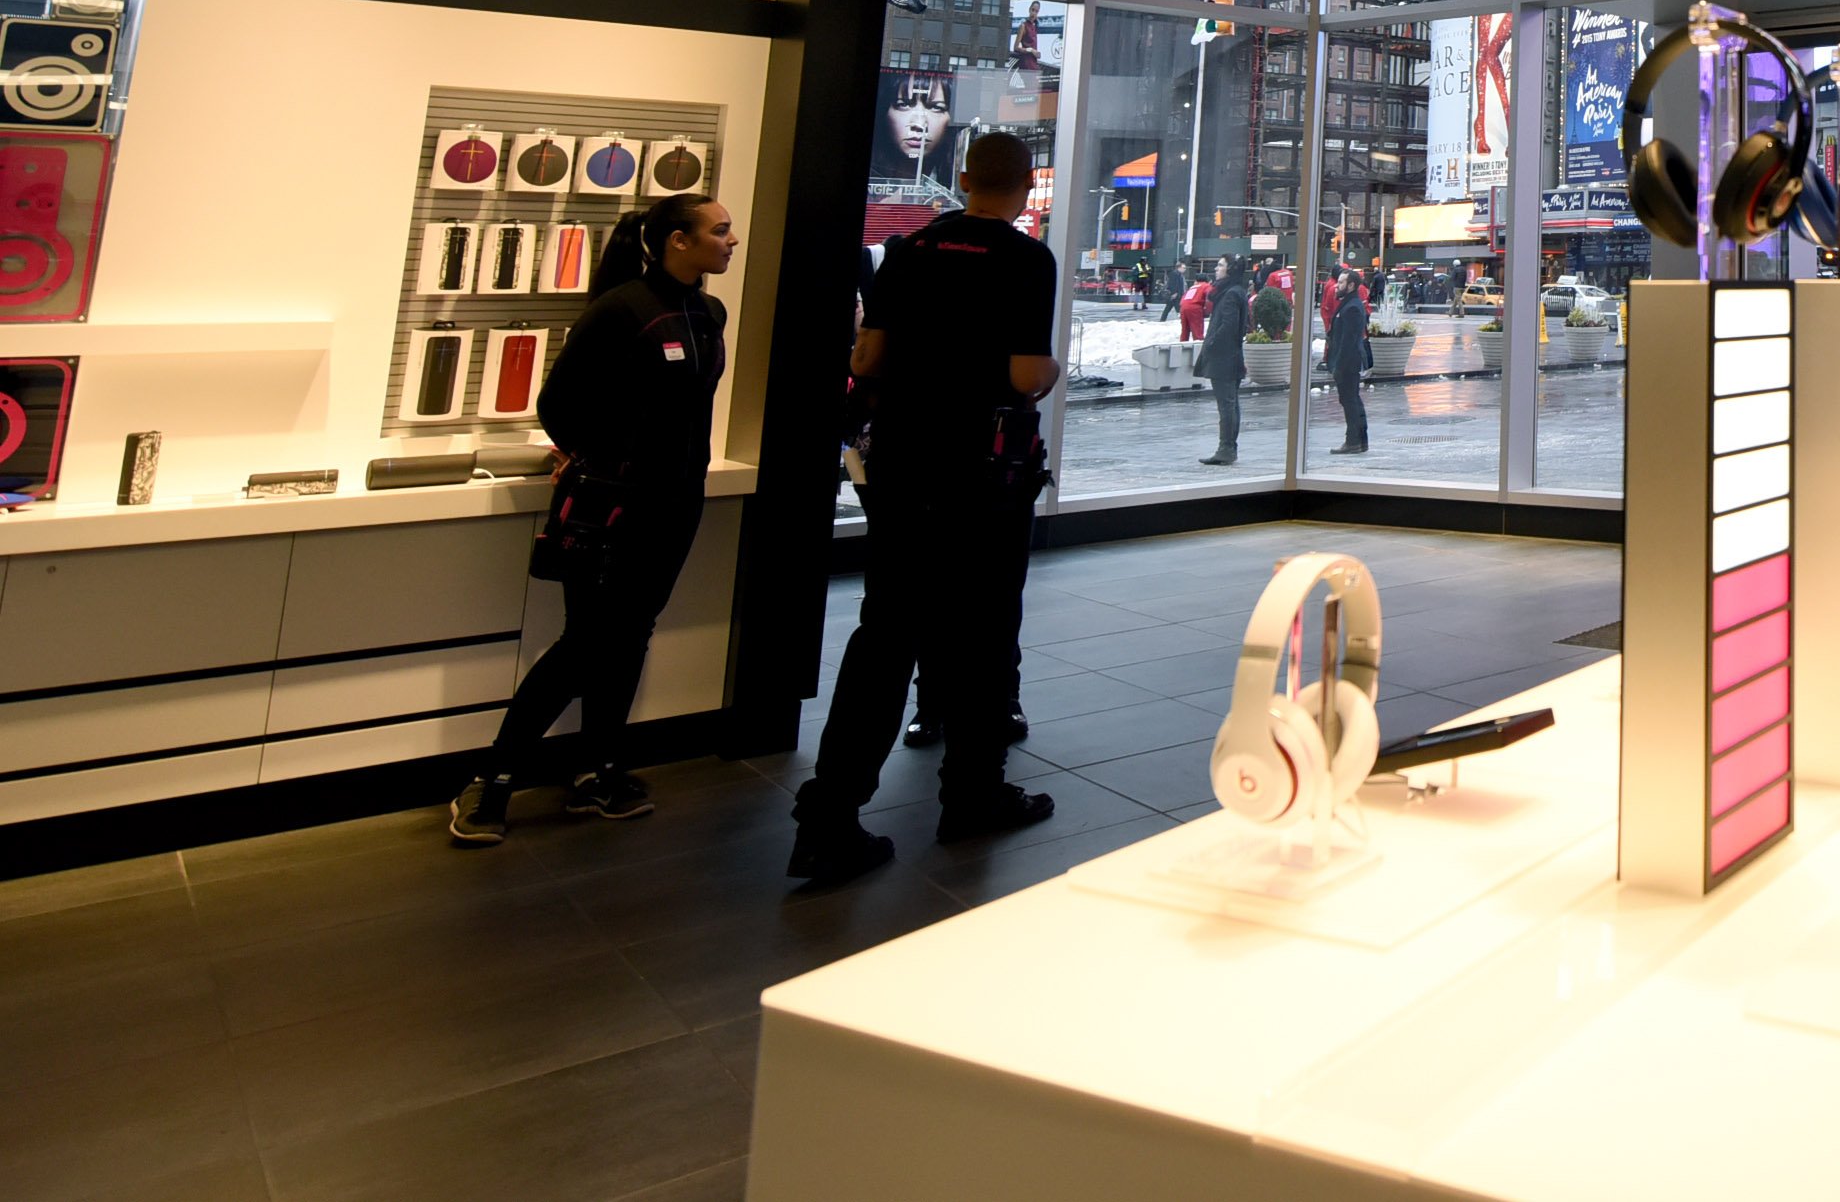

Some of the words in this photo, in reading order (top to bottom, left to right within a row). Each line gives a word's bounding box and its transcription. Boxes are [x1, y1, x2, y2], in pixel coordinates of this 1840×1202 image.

[1571, 32, 1582, 49] 4
[1581, 34, 1593, 45] 2015
[1593, 31, 1607, 43] TONY
[1606, 27, 1628, 40] AWARDS
[1433, 45, 1454, 72] AR
[1456, 49, 1466, 62] &
[1433, 71, 1470, 98] ACE
[1576, 82, 1623, 112] American
[1451, 142, 1462, 154] 18
[1495, 160, 1507, 169] TONY
